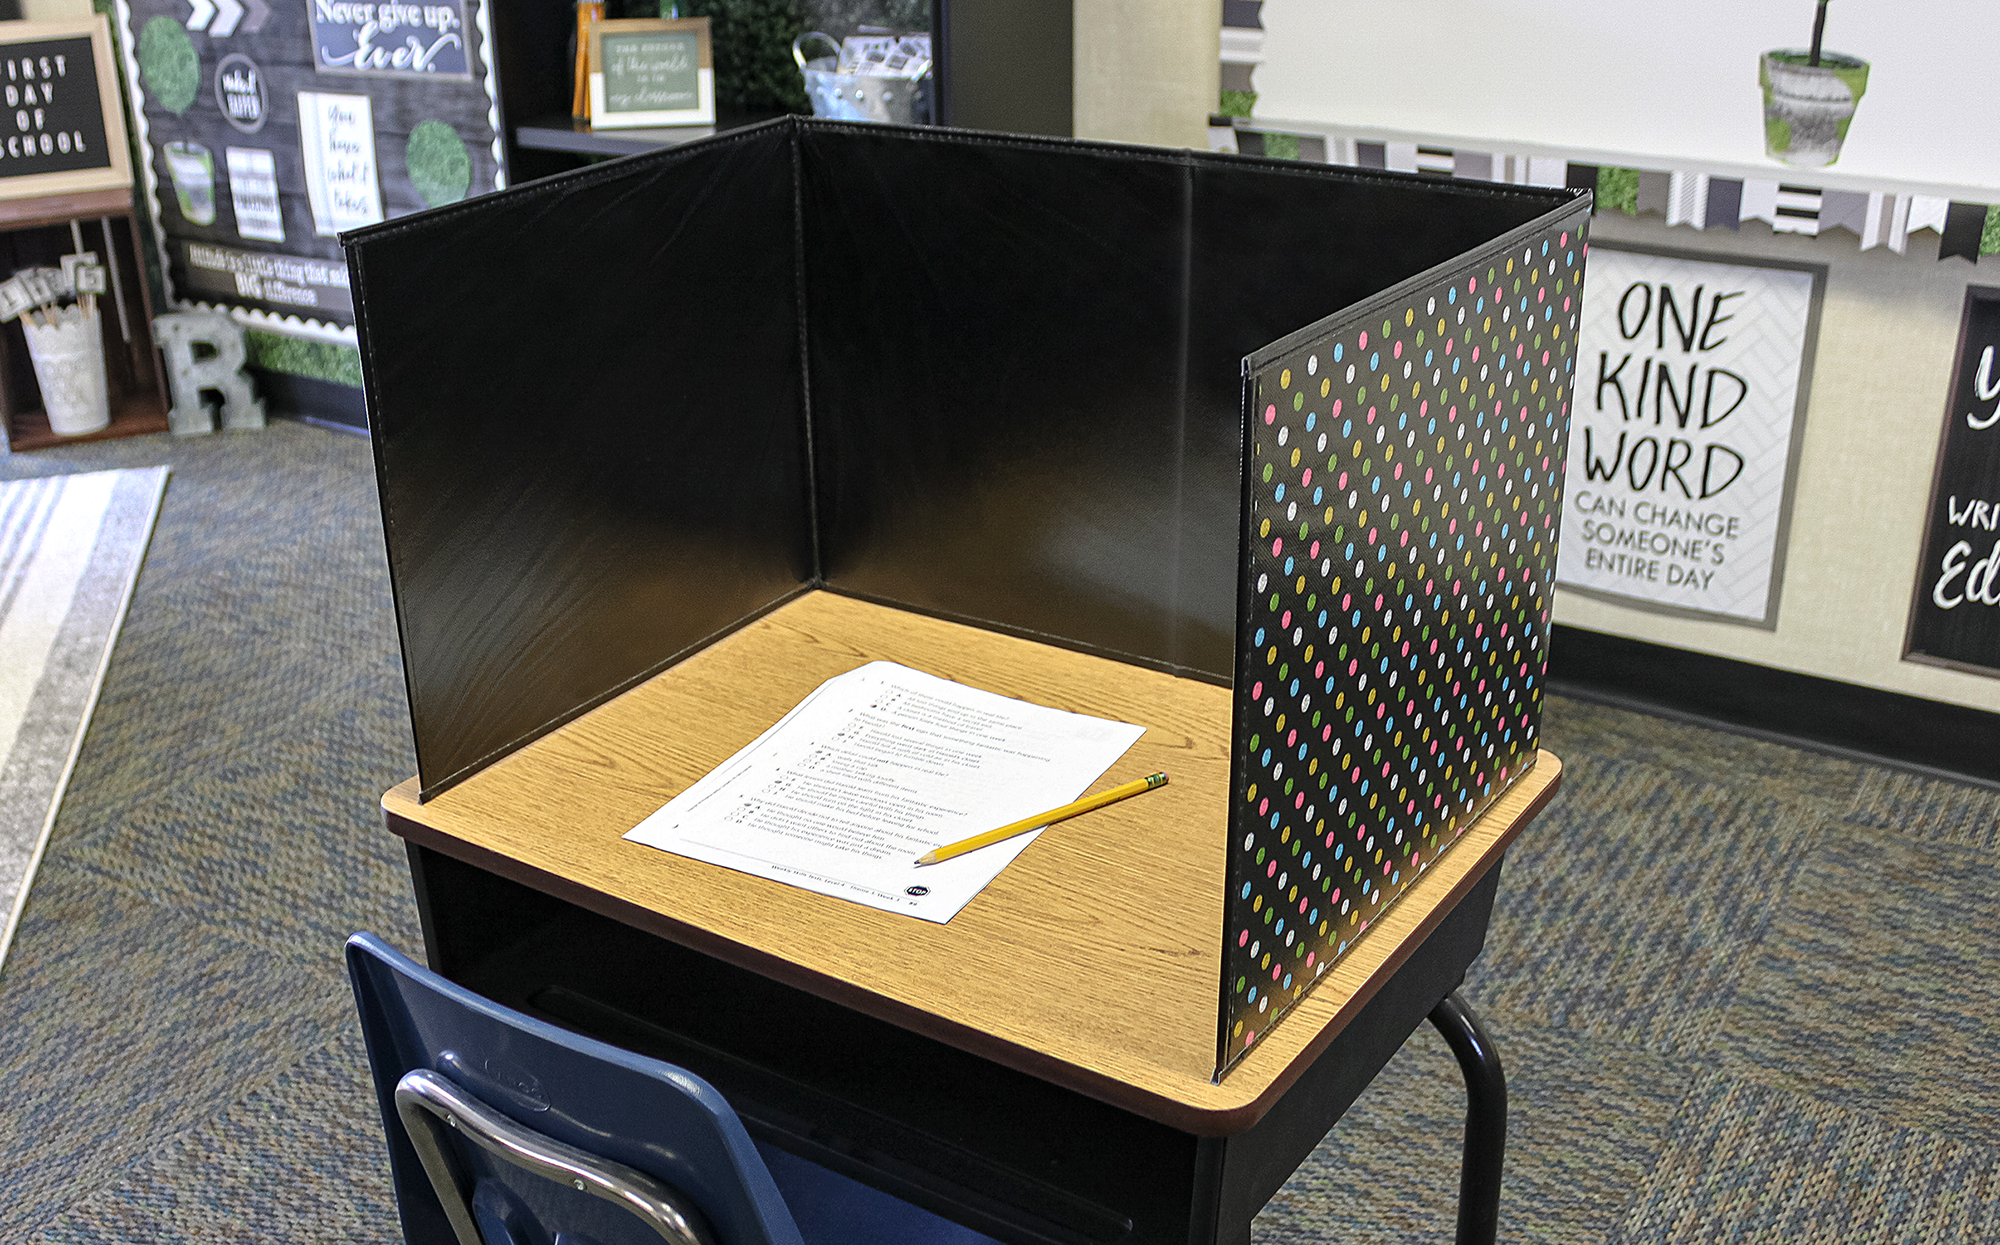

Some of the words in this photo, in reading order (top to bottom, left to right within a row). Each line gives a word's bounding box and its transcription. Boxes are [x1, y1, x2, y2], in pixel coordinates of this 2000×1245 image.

[316, 0, 376, 25] Never
[378, 0, 423, 34] give
[424, 5, 461, 35] up.
[0, 54, 66, 81] IRST
[5, 82, 53, 107] DAY
[16, 107, 45, 132] OF
[235, 272, 263, 299] BIG
[1617, 280, 1746, 352] ONE
[152, 313, 266, 435] R
[1596, 350, 1749, 430] KIND
[1583, 425, 1745, 499] WORD
[1574, 490, 1627, 518] CAN
[1633, 500, 1740, 540] CHANGE
[1949, 495, 2000, 532] WRI
[1580, 519, 1726, 566] SOMEONE'S
[1585, 548, 1659, 583] ENTIRE
[1666, 564, 1716, 592] DAY
[1933, 539, 2000, 610] Ed
